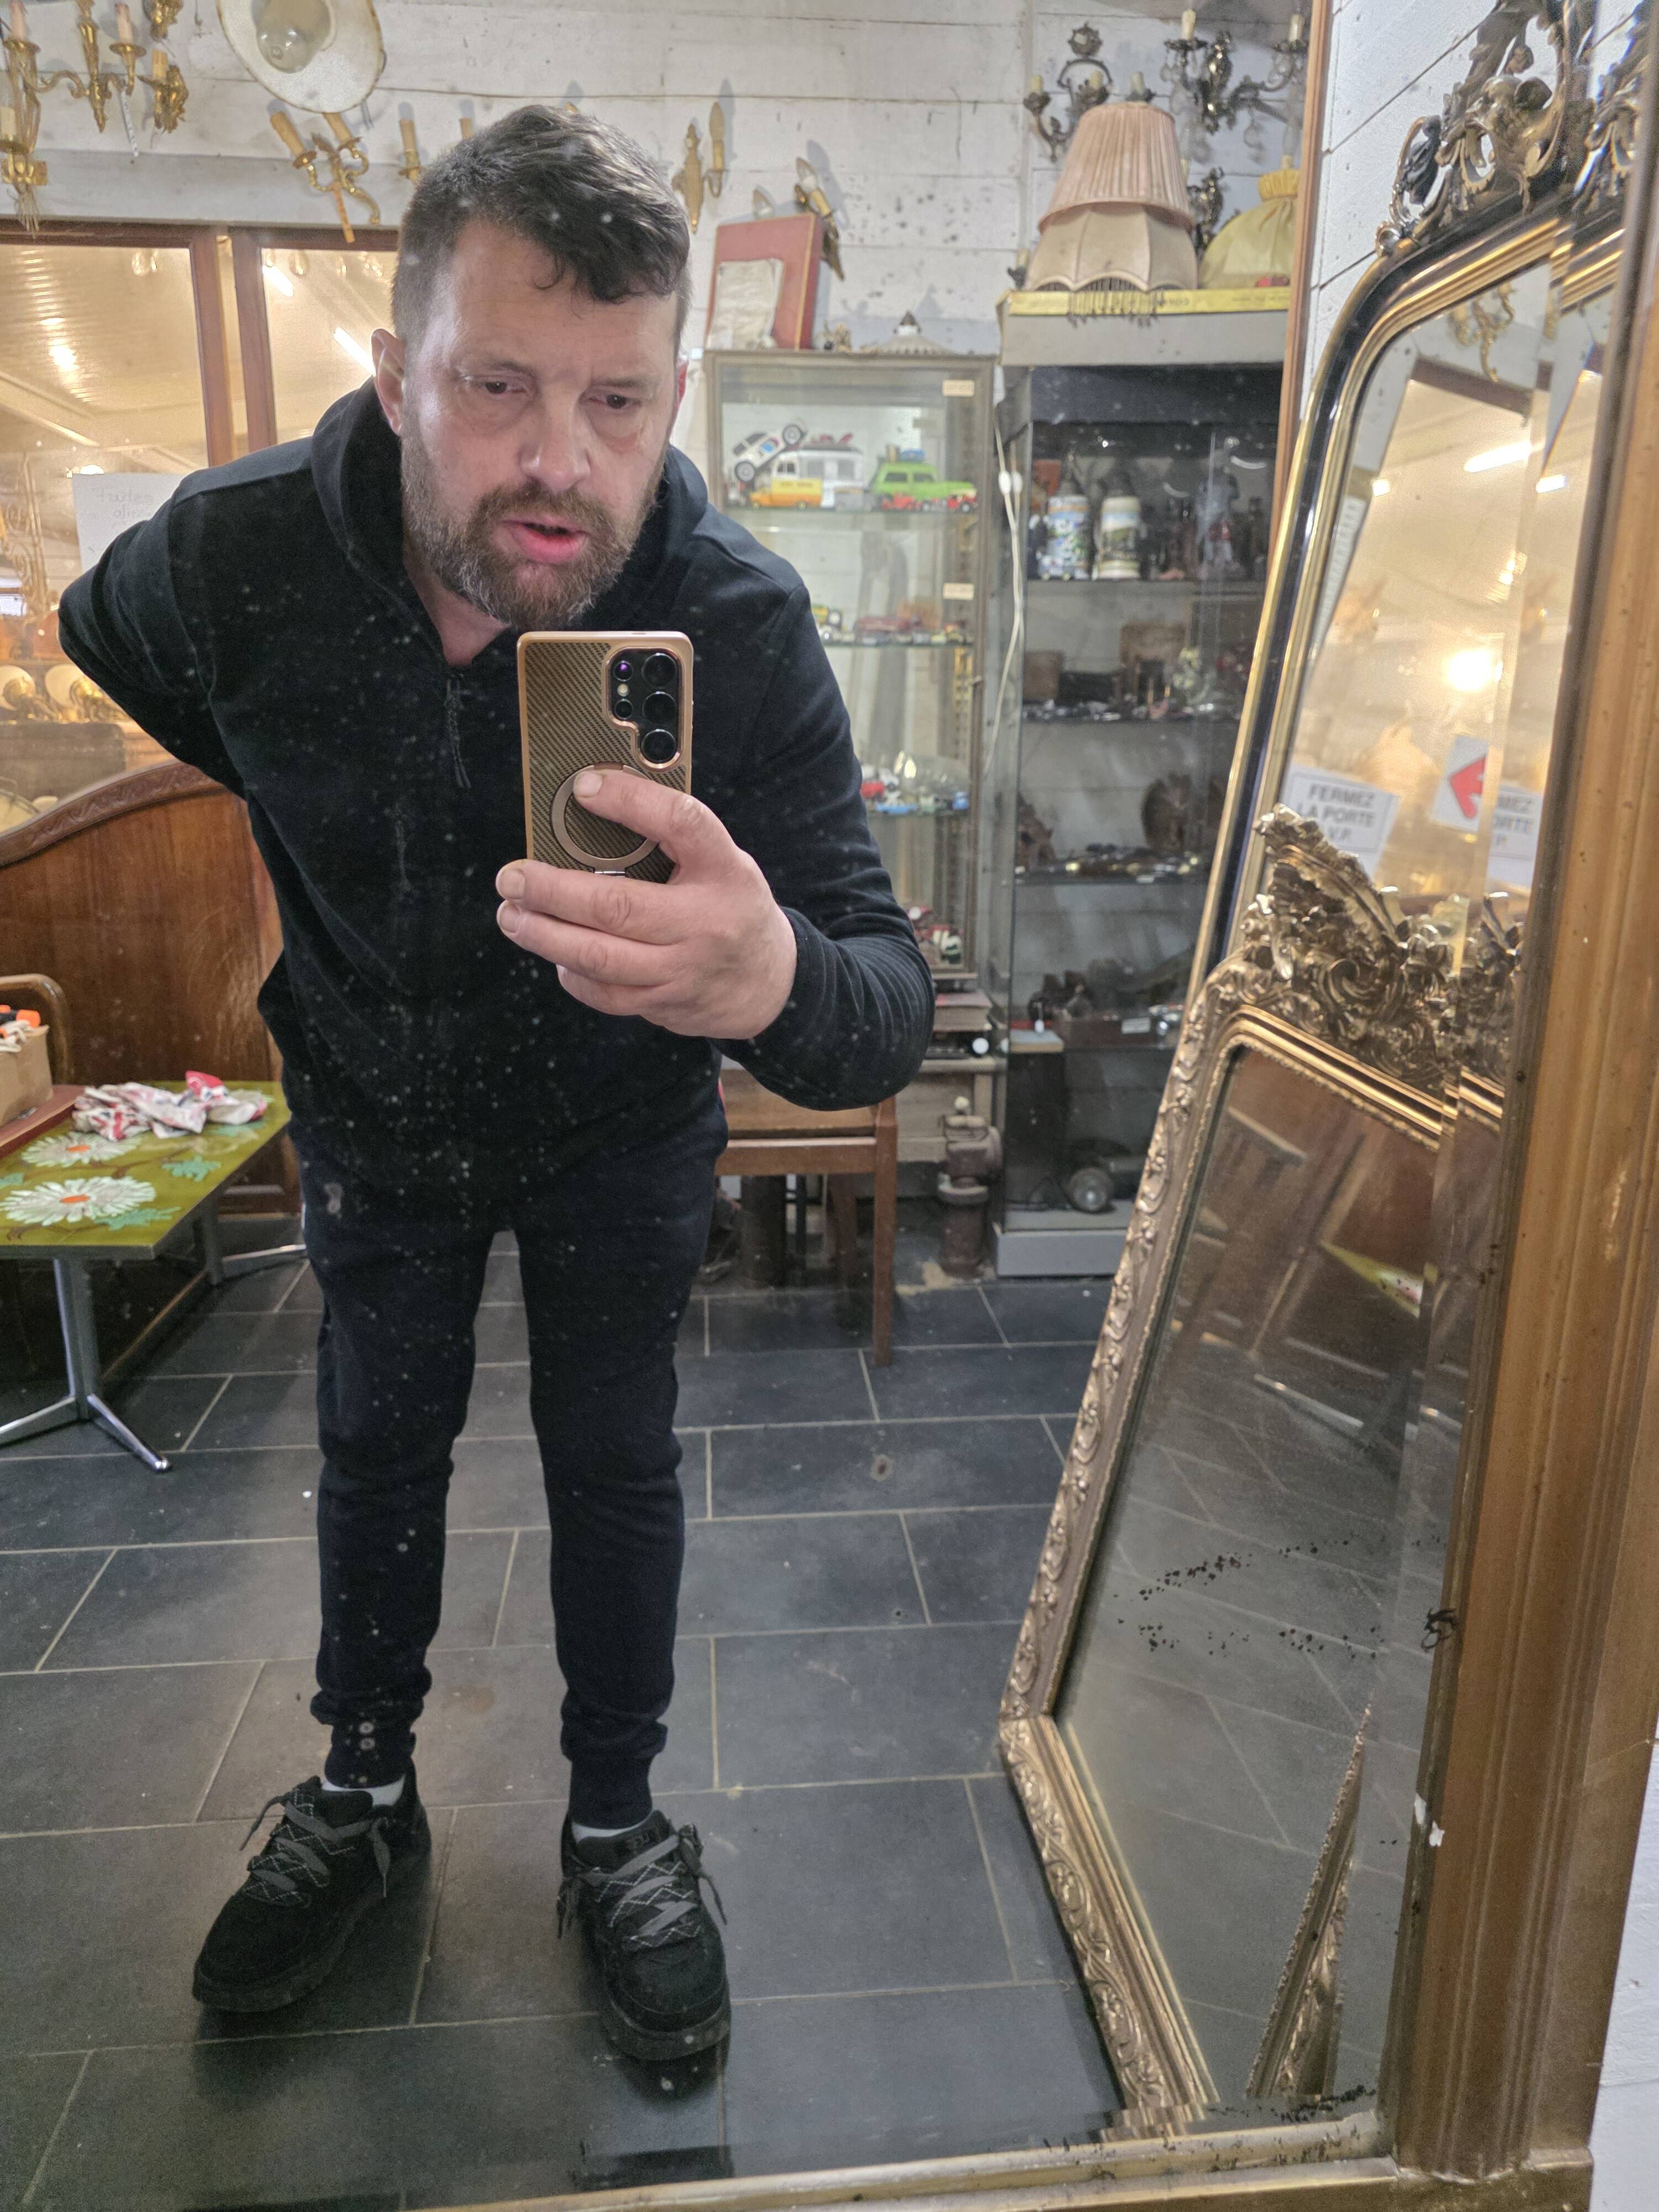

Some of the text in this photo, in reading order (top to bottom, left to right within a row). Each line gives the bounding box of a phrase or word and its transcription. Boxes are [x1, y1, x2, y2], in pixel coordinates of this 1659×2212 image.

[1307, 783, 1375, 806] FERMEZ
[1323, 805, 1376, 828] PORTE
[1493, 813, 1533, 836] ORTE
